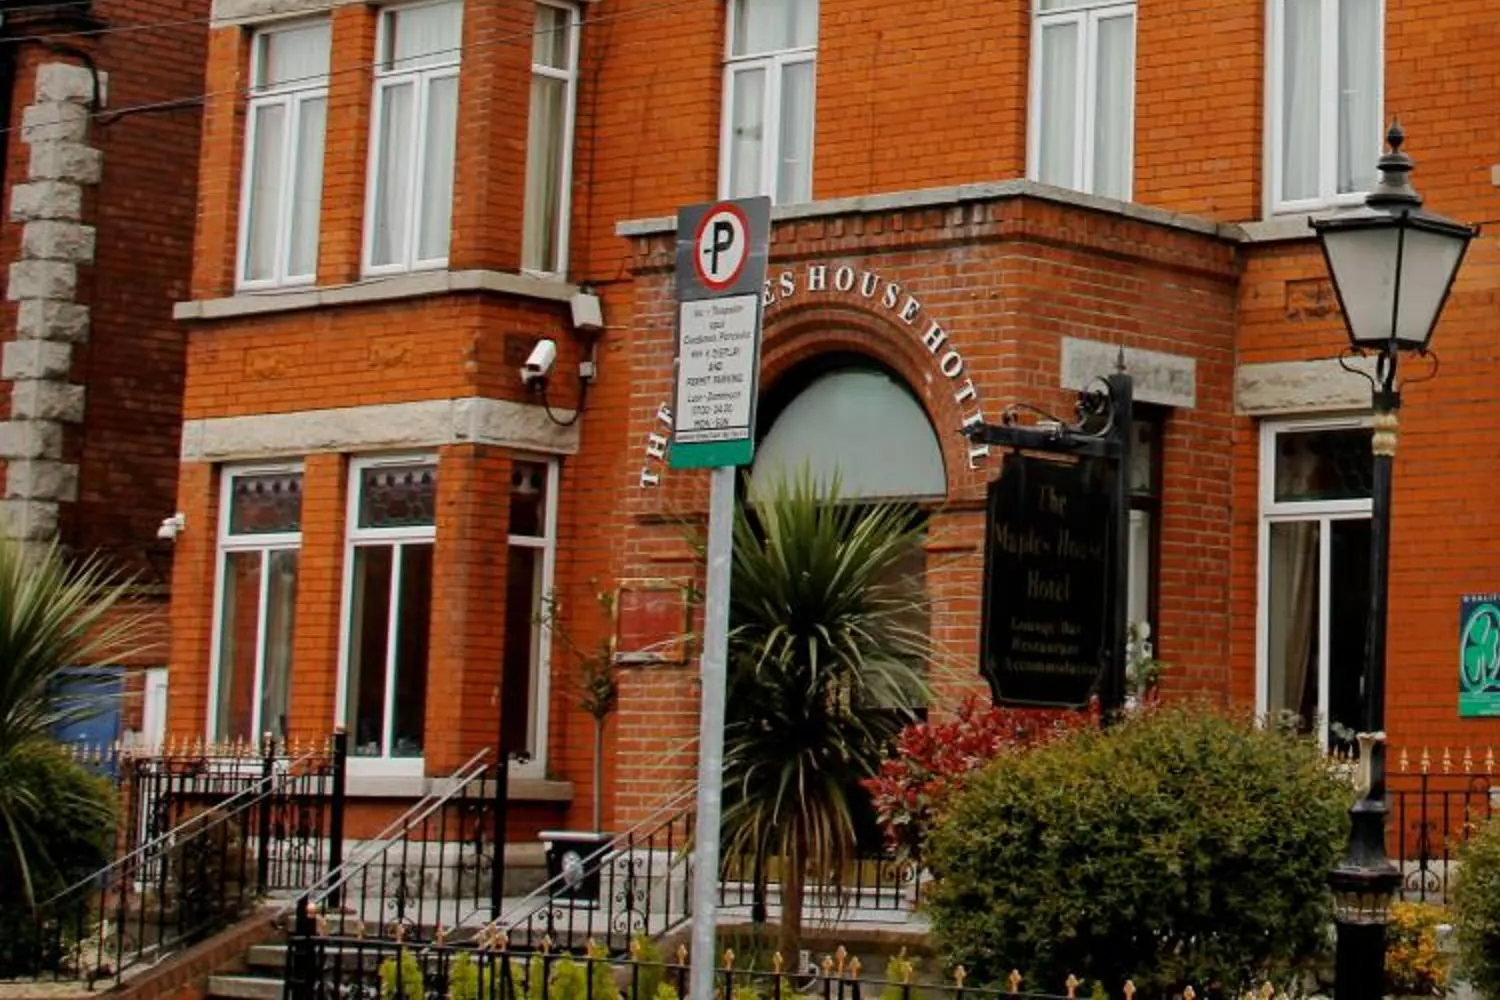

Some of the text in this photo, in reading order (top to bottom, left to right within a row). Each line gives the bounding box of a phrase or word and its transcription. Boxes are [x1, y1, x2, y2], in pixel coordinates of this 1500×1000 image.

[711, 221, 735, 274] P
[807, 265, 921, 325] HOUSE
[1027, 567, 1070, 601] Hotel
